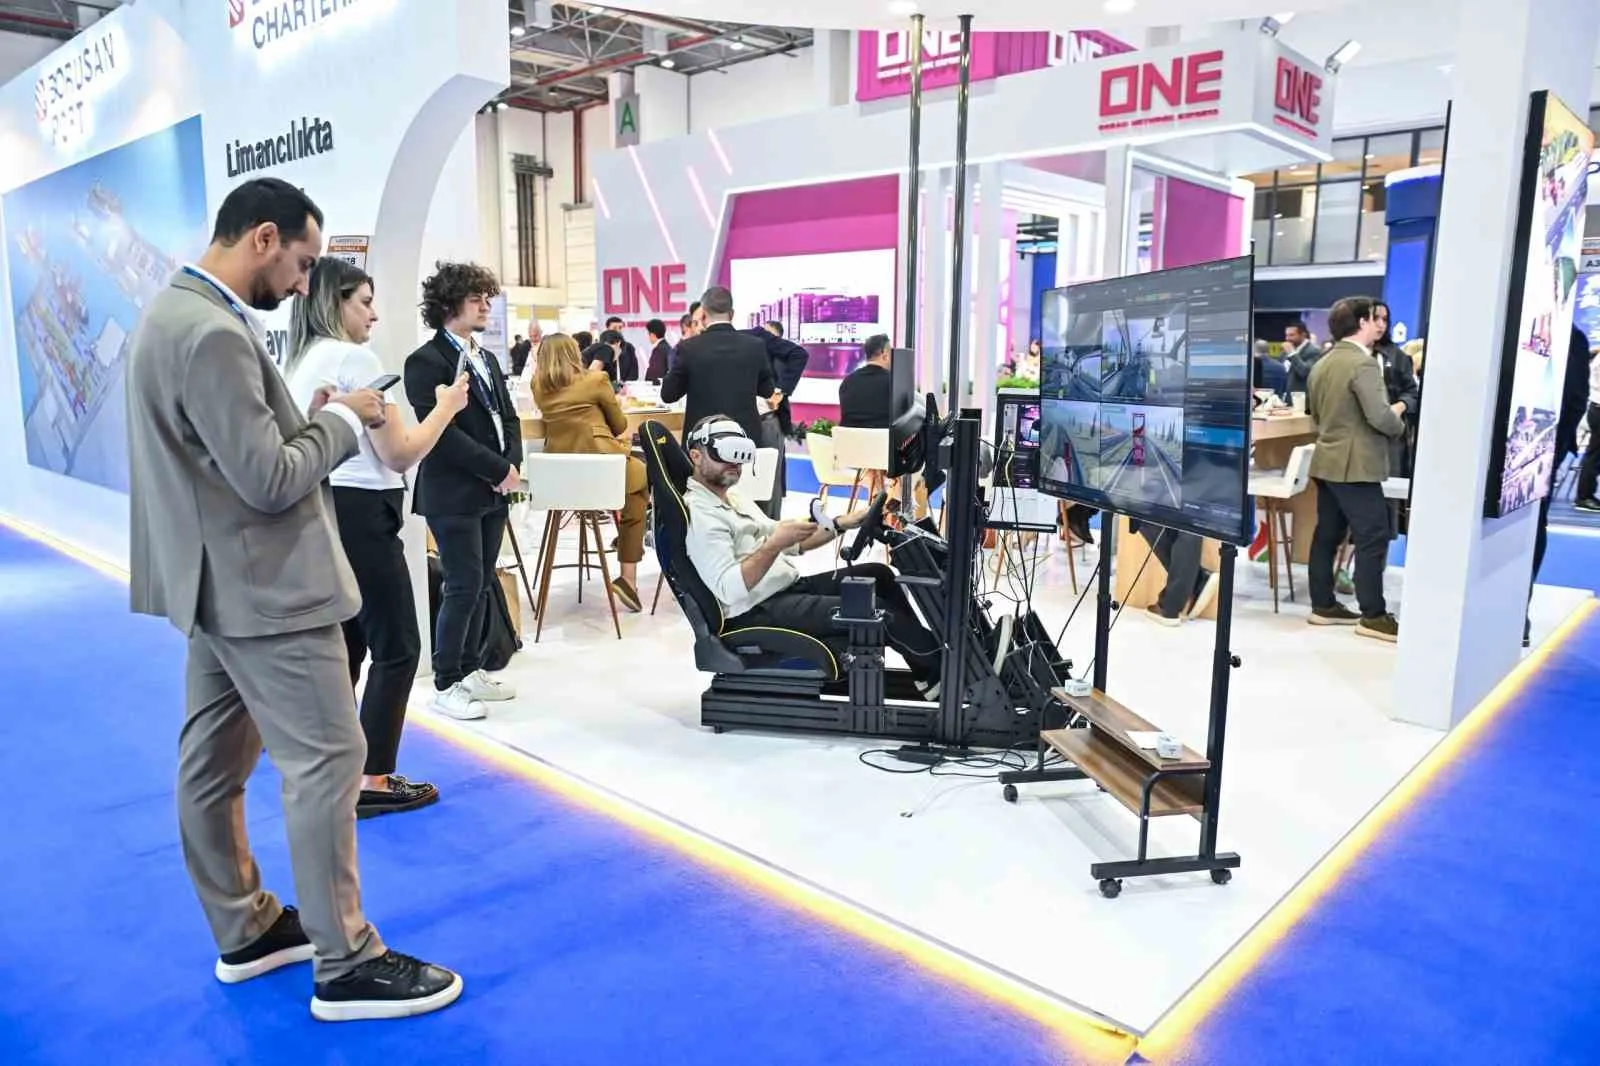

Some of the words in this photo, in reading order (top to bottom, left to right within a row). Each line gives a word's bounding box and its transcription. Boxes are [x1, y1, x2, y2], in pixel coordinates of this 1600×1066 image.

[252, 0, 353, 49] CHARTE
[1099, 50, 1223, 117] ONE
[1274, 56, 1322, 125] ONE
[619, 101, 636, 135] A
[603, 263, 686, 314] ONE
